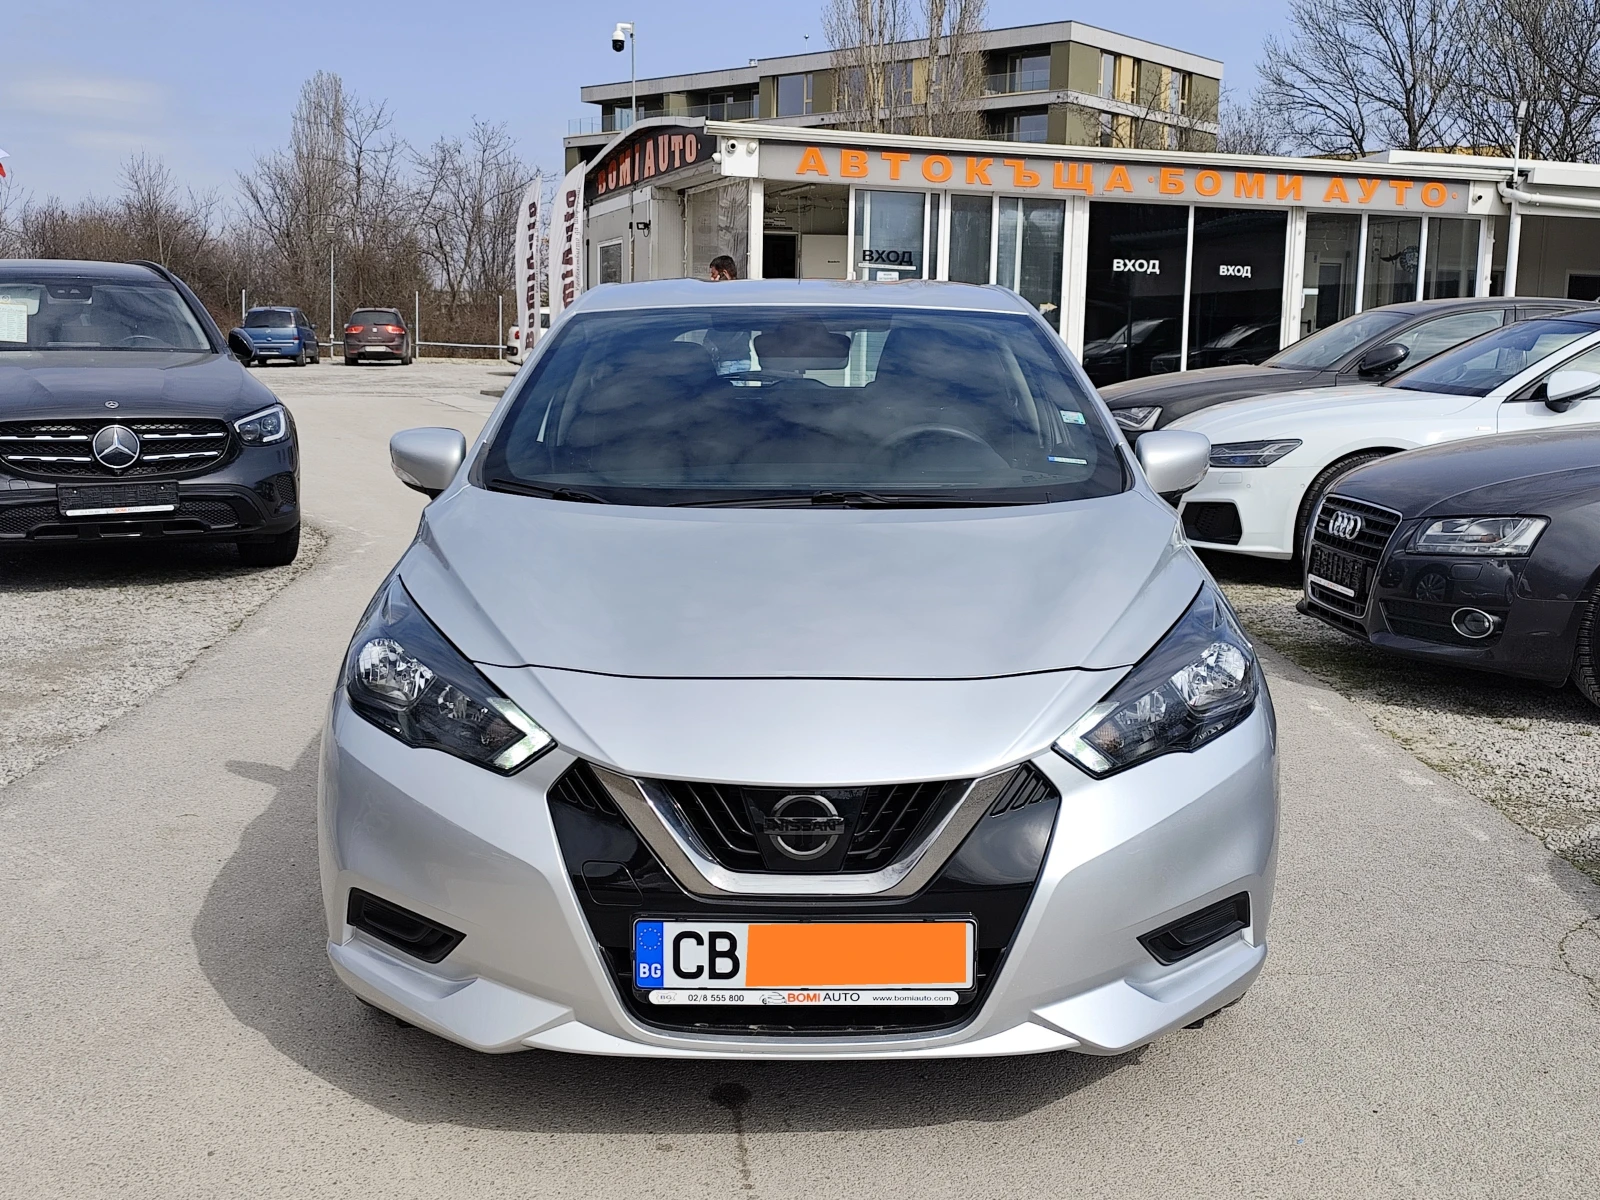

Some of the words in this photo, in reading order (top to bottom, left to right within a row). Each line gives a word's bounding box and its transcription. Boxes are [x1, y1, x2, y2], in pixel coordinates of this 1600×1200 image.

[596, 143, 641, 194] BOMI
[644, 133, 698, 178] AUTO
[796, 146, 1134, 195] АВТОКЪЩА
[1159, 167, 1303, 201] БОМИ
[1322, 175, 1448, 208] АУТО
[862, 249, 913, 266] ВХОД
[1112, 258, 1160, 275] ВХОД
[1219, 264, 1252, 278] ВХОД
[766, 818, 839, 832] NISSAN
[639, 963, 662, 978] BG
[688, 994, 708, 1002] 02/8
[711, 994, 727, 1002] 555
[728, 994, 745, 1002] 800
[787, 993, 821, 1003] BOMI
[823, 992, 860, 1002] AUTO
